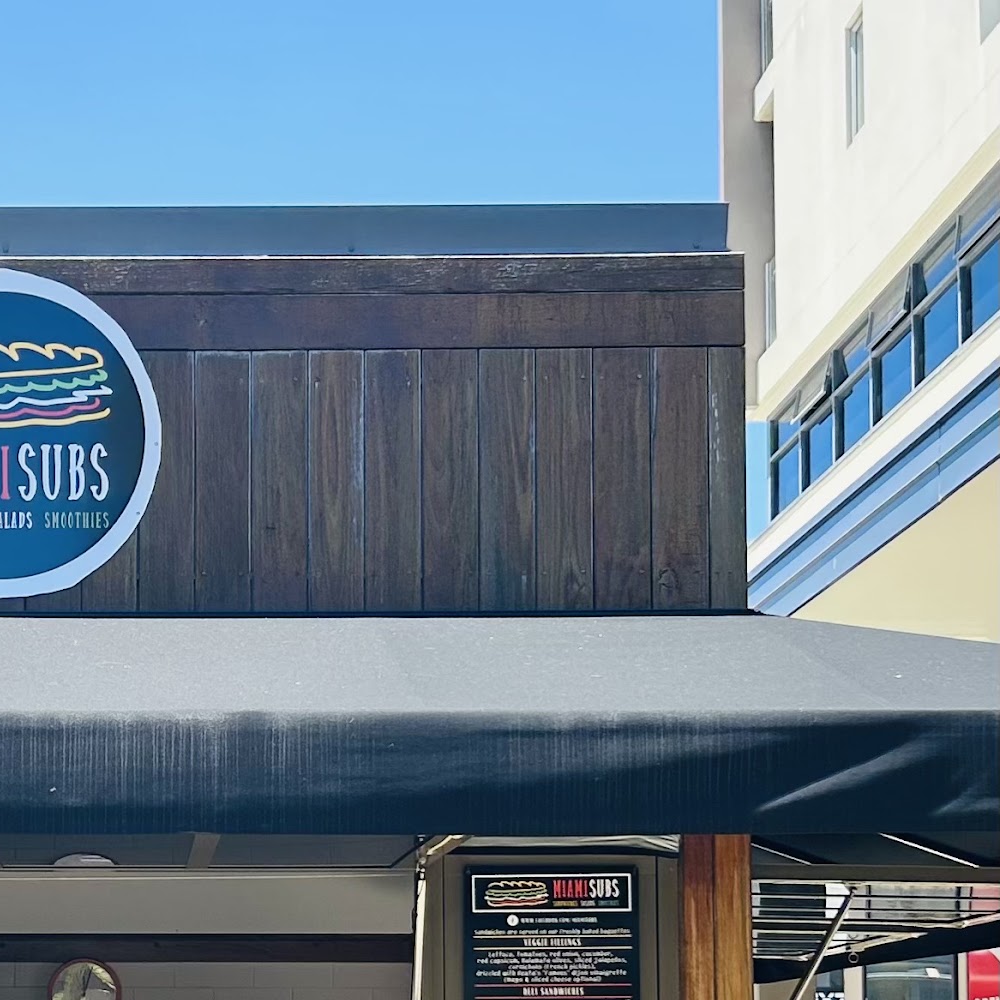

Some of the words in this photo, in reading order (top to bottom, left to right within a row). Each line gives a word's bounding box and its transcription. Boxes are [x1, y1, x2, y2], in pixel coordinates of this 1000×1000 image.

[44, 511, 110, 530] SMOOTHIES
[523, 938, 548, 946] VEGGIE
[540, 987, 584, 996] SANDWICHES
